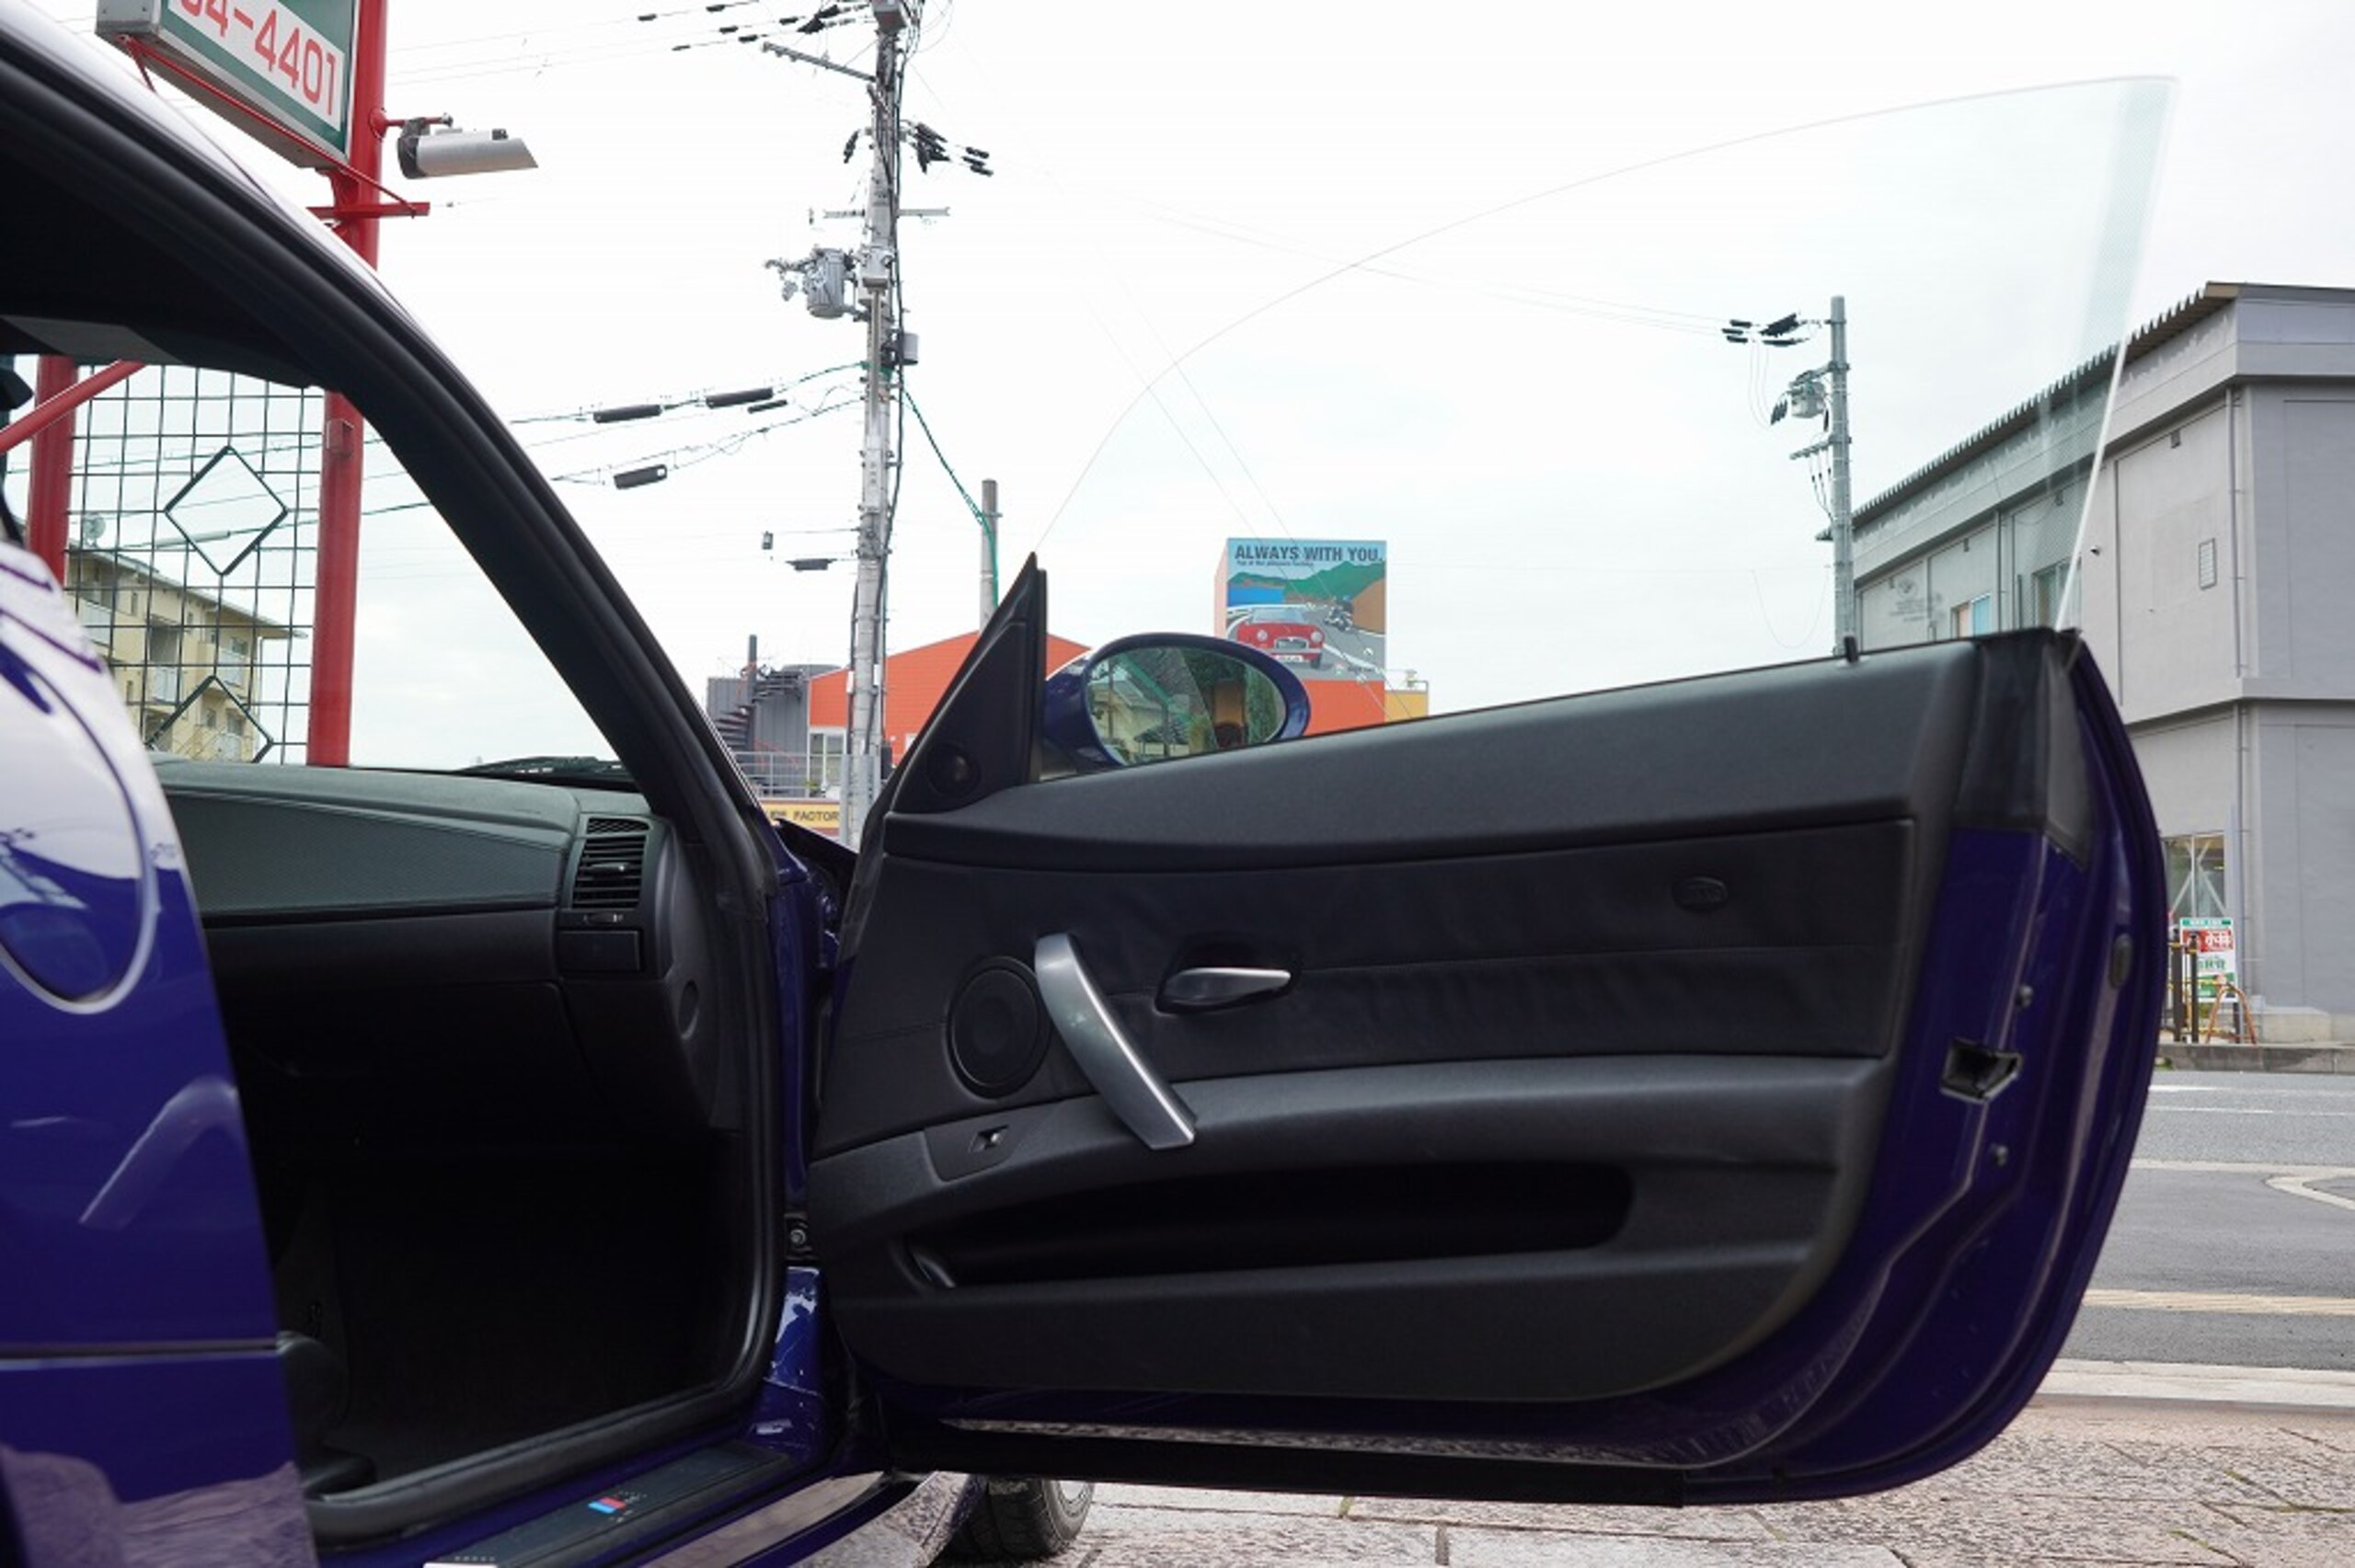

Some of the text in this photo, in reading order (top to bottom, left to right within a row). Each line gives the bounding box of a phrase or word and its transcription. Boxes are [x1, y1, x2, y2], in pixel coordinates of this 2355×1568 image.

[181, 0, 337, 116] 4-4401
[1235, 544, 1384, 563] ALWAYS WITH YOU.
